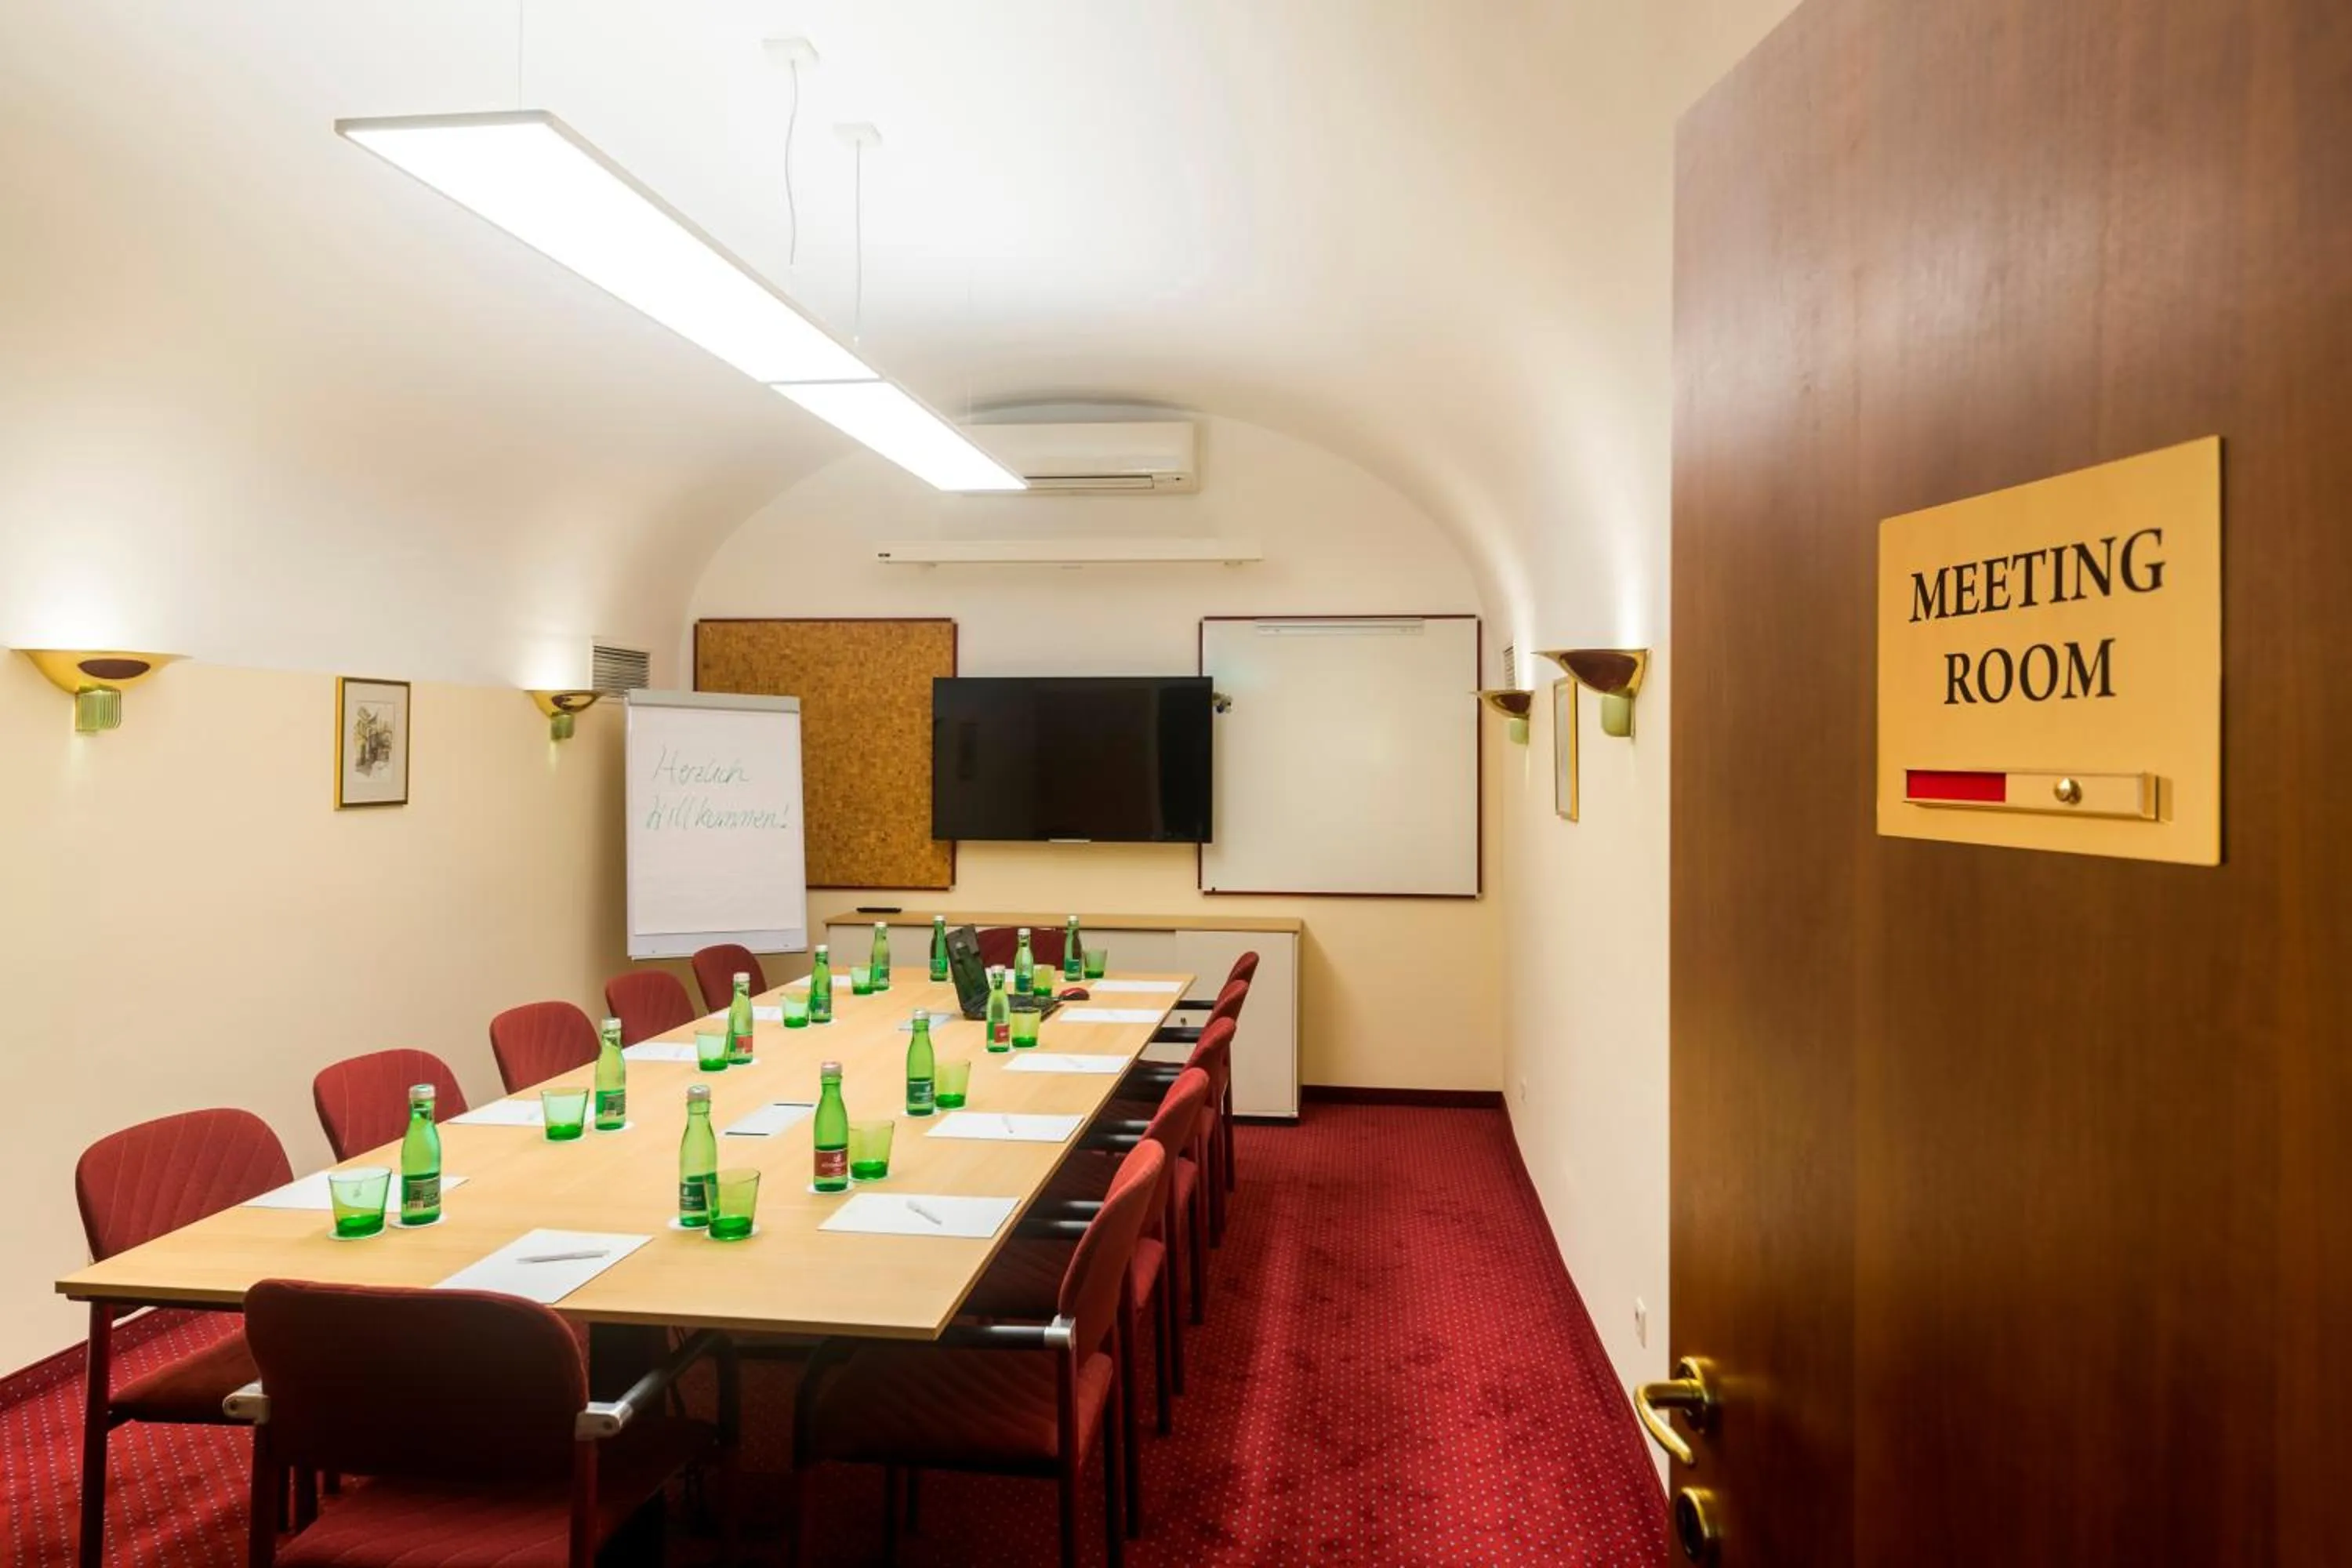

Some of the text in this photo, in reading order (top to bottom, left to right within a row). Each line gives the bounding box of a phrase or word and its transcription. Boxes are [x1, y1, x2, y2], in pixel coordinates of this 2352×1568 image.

[1908, 528, 2166, 623] MEETING
[1944, 637, 2116, 705] ROOM
[652, 744, 750, 785] Herzlich
